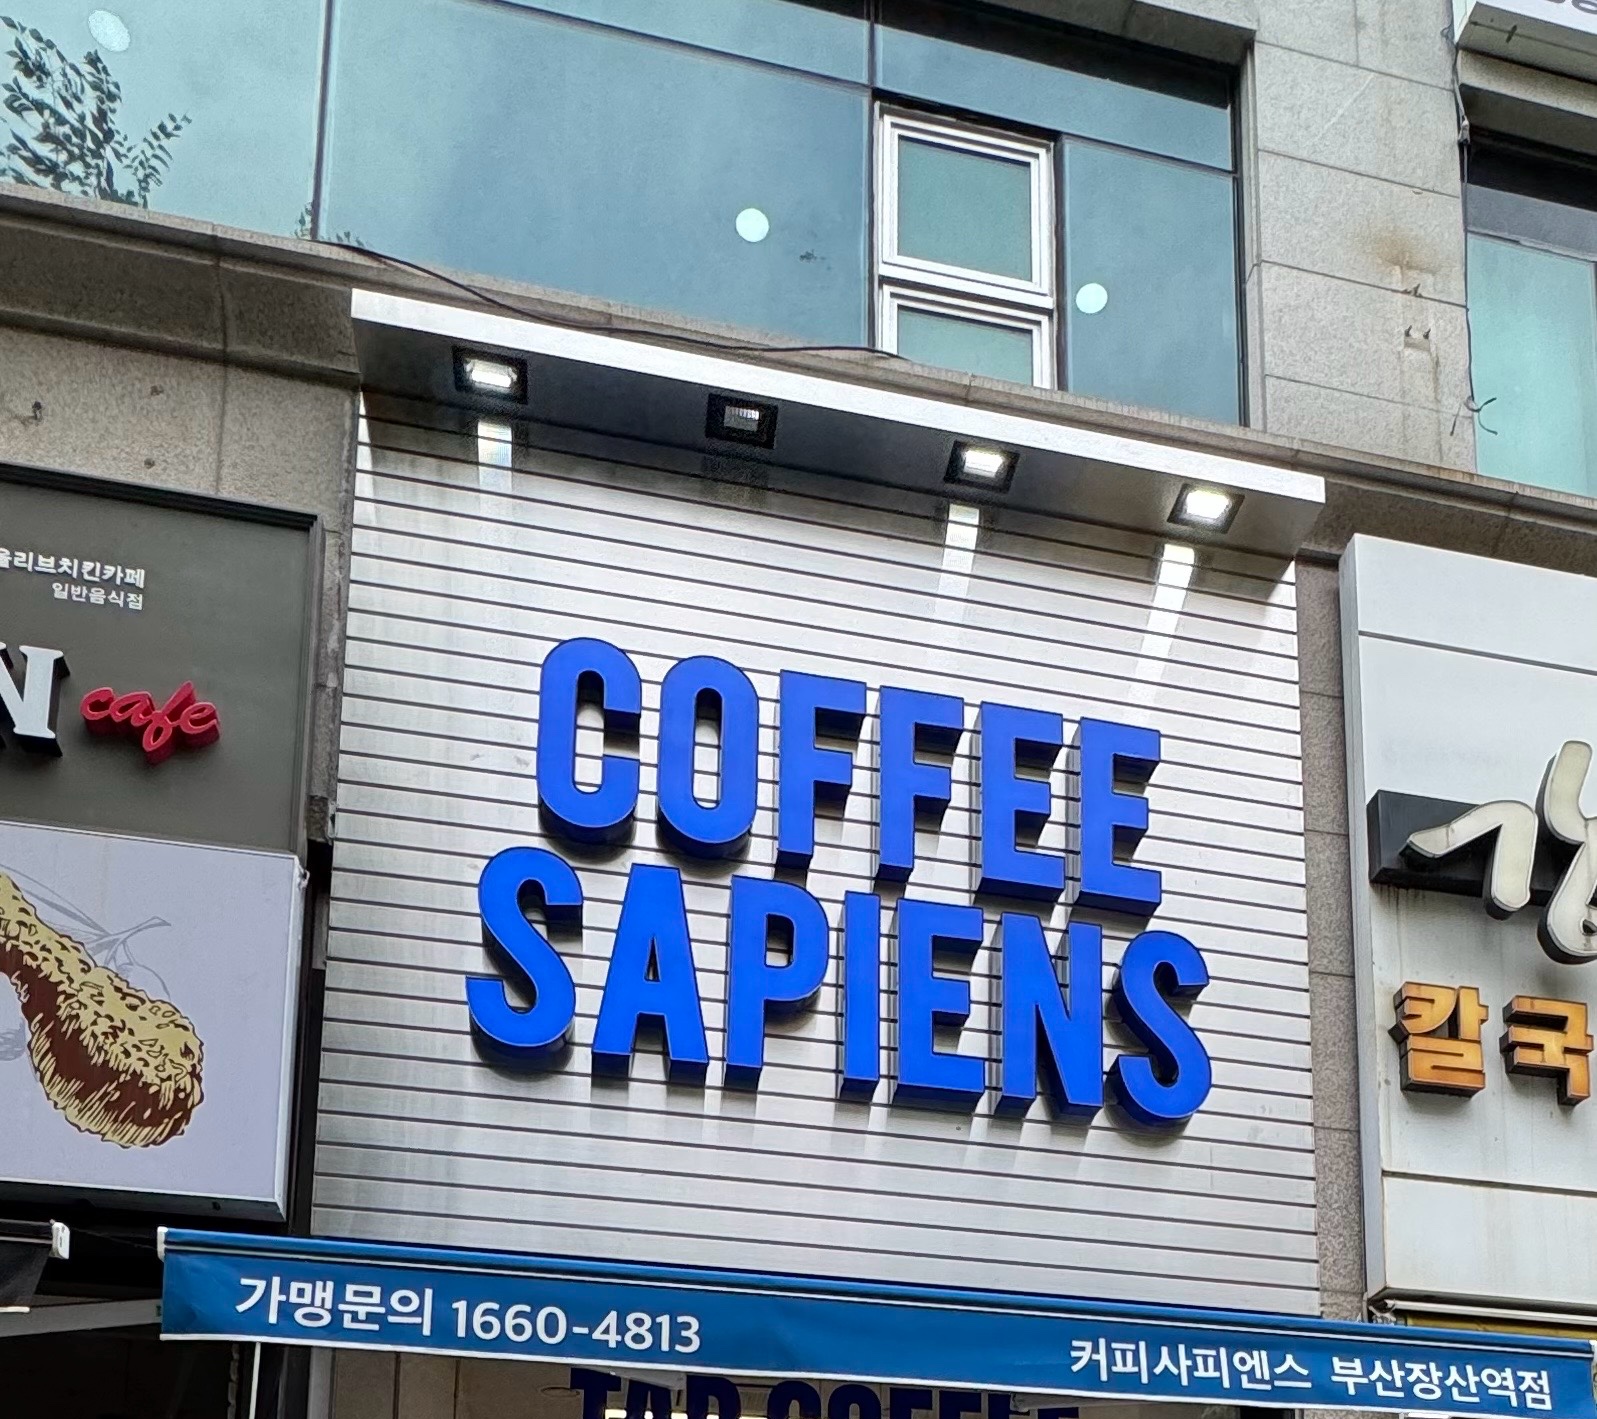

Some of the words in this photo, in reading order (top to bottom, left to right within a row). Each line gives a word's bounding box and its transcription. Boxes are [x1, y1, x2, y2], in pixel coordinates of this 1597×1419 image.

[52, 582, 143, 611] 일반음식점
[79, 680, 221, 757] cafe
[535, 636, 1162, 914] COFFEE
[465, 845, 1213, 1125] SAPIENS
[235, 1276, 435, 1338] 가맹문의
[451, 1299, 701, 1355] 1660-4813
[1069, 1337, 1313, 1392] 커피사피엔스
[1330, 1356, 1554, 1411] 부산장산역점
